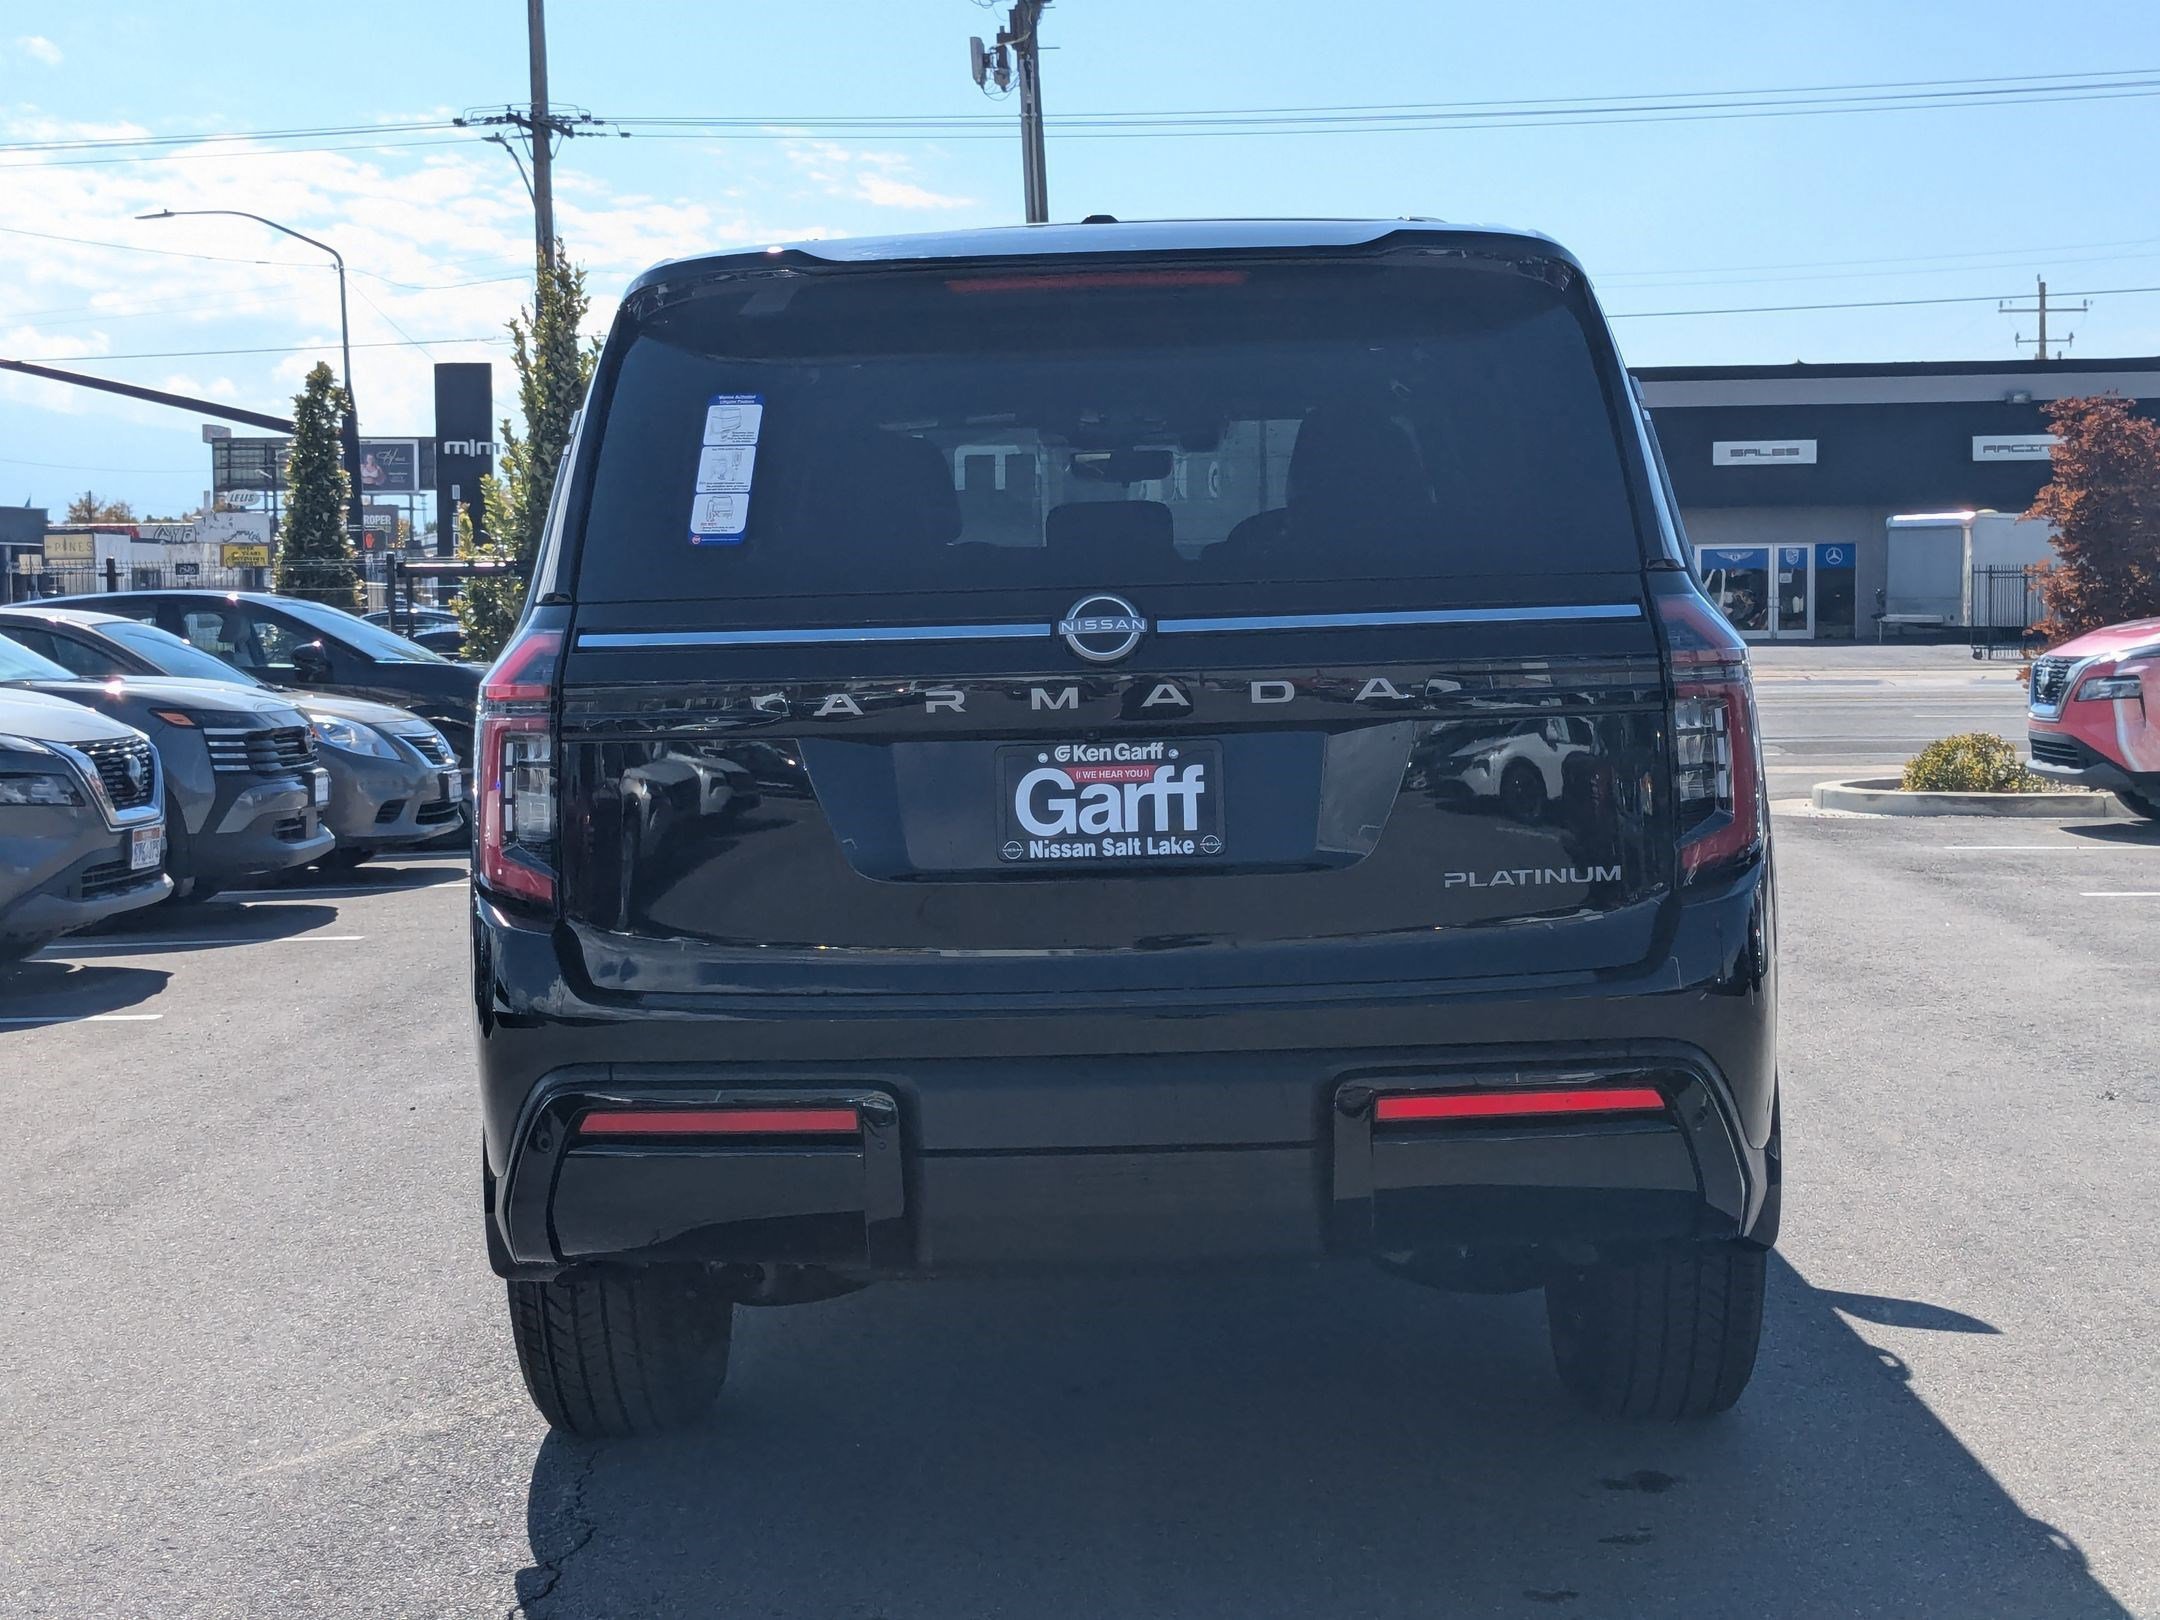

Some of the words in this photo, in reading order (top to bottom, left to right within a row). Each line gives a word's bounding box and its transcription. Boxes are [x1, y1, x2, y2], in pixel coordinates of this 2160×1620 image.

[1730, 447, 1800, 457] SALES
[1983, 444, 2054, 454] RACIN
[363, 515, 391, 525] ROPER
[1060, 618, 1146, 632] NISSAN
[812, 677, 1402, 717] ARMADA
[1073, 744, 1112, 762] Ken
[1114, 742, 1164, 761] Garff
[1082, 770, 1097, 779] WE
[1098, 769, 1123, 779] HEAR
[1124, 768, 1143, 778] YOU
[1015, 764, 1205, 837] Garff
[1029, 840, 1096, 859] Nissan
[1102, 837, 1141, 857] Salt
[1147, 836, 1195, 856] Lake
[1444, 865, 1622, 888] PLATINUM
